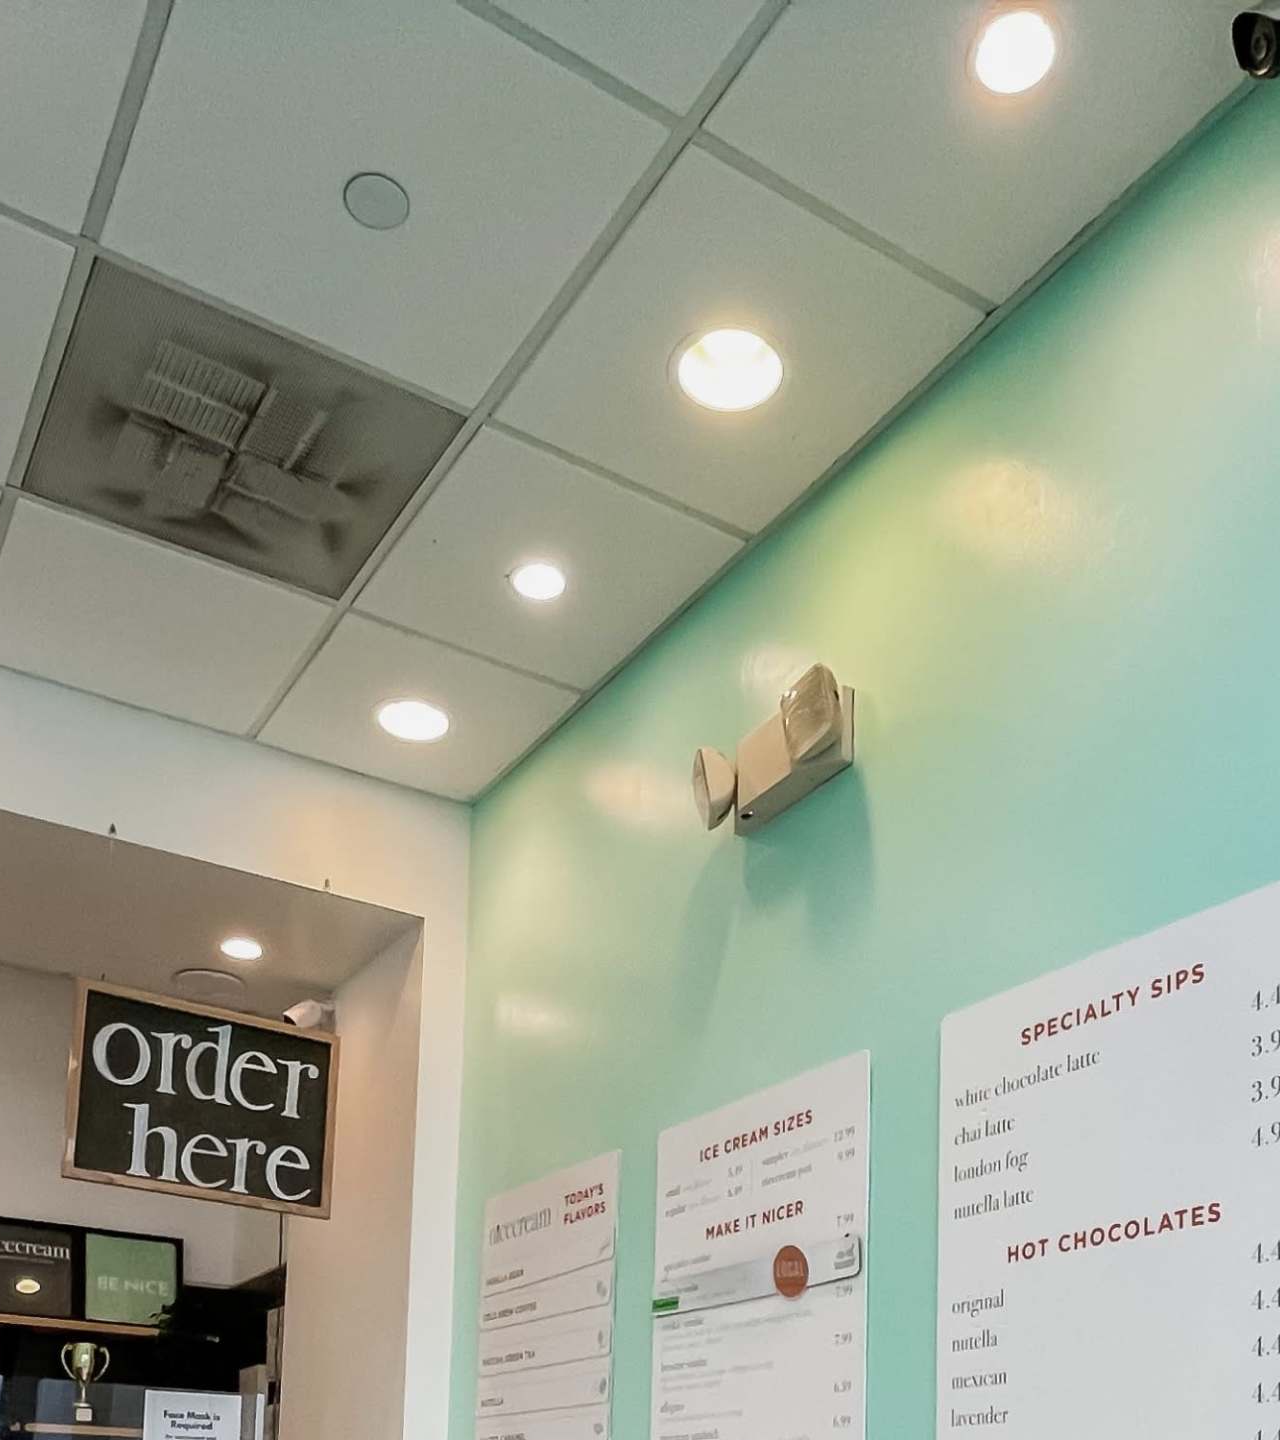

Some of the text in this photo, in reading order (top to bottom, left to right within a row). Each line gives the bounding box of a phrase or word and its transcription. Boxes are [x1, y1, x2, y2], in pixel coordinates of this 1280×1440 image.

[1020, 963, 1206, 1046] SPECIALTY SIPS
[92, 1022, 320, 1119] order
[954, 1049, 1101, 1109] white chocolate latte
[699, 1143, 720, 1163] ICE
[724, 1126, 769, 1154] CREAM
[773, 1110, 813, 1136] SIZES
[953, 1117, 1016, 1146] chai latte
[122, 1103, 311, 1200] here
[953, 1150, 1029, 1183] london fog
[563, 1201, 606, 1225] FLAVORS
[706, 1200, 804, 1240] MAKE IT NICER
[953, 1188, 1034, 1220] nutella latte
[1007, 1203, 1221, 1264] HOT CHOCOLATES
[97, 1275, 169, 1296] BE NICE
[951, 1289, 1005, 1318] original
[951, 1329, 998, 1353] nutella
[951, 1371, 1008, 1390] mexican
[171, 1420, 213, 1431] Required
[951, 1406, 1009, 1428] lavender
